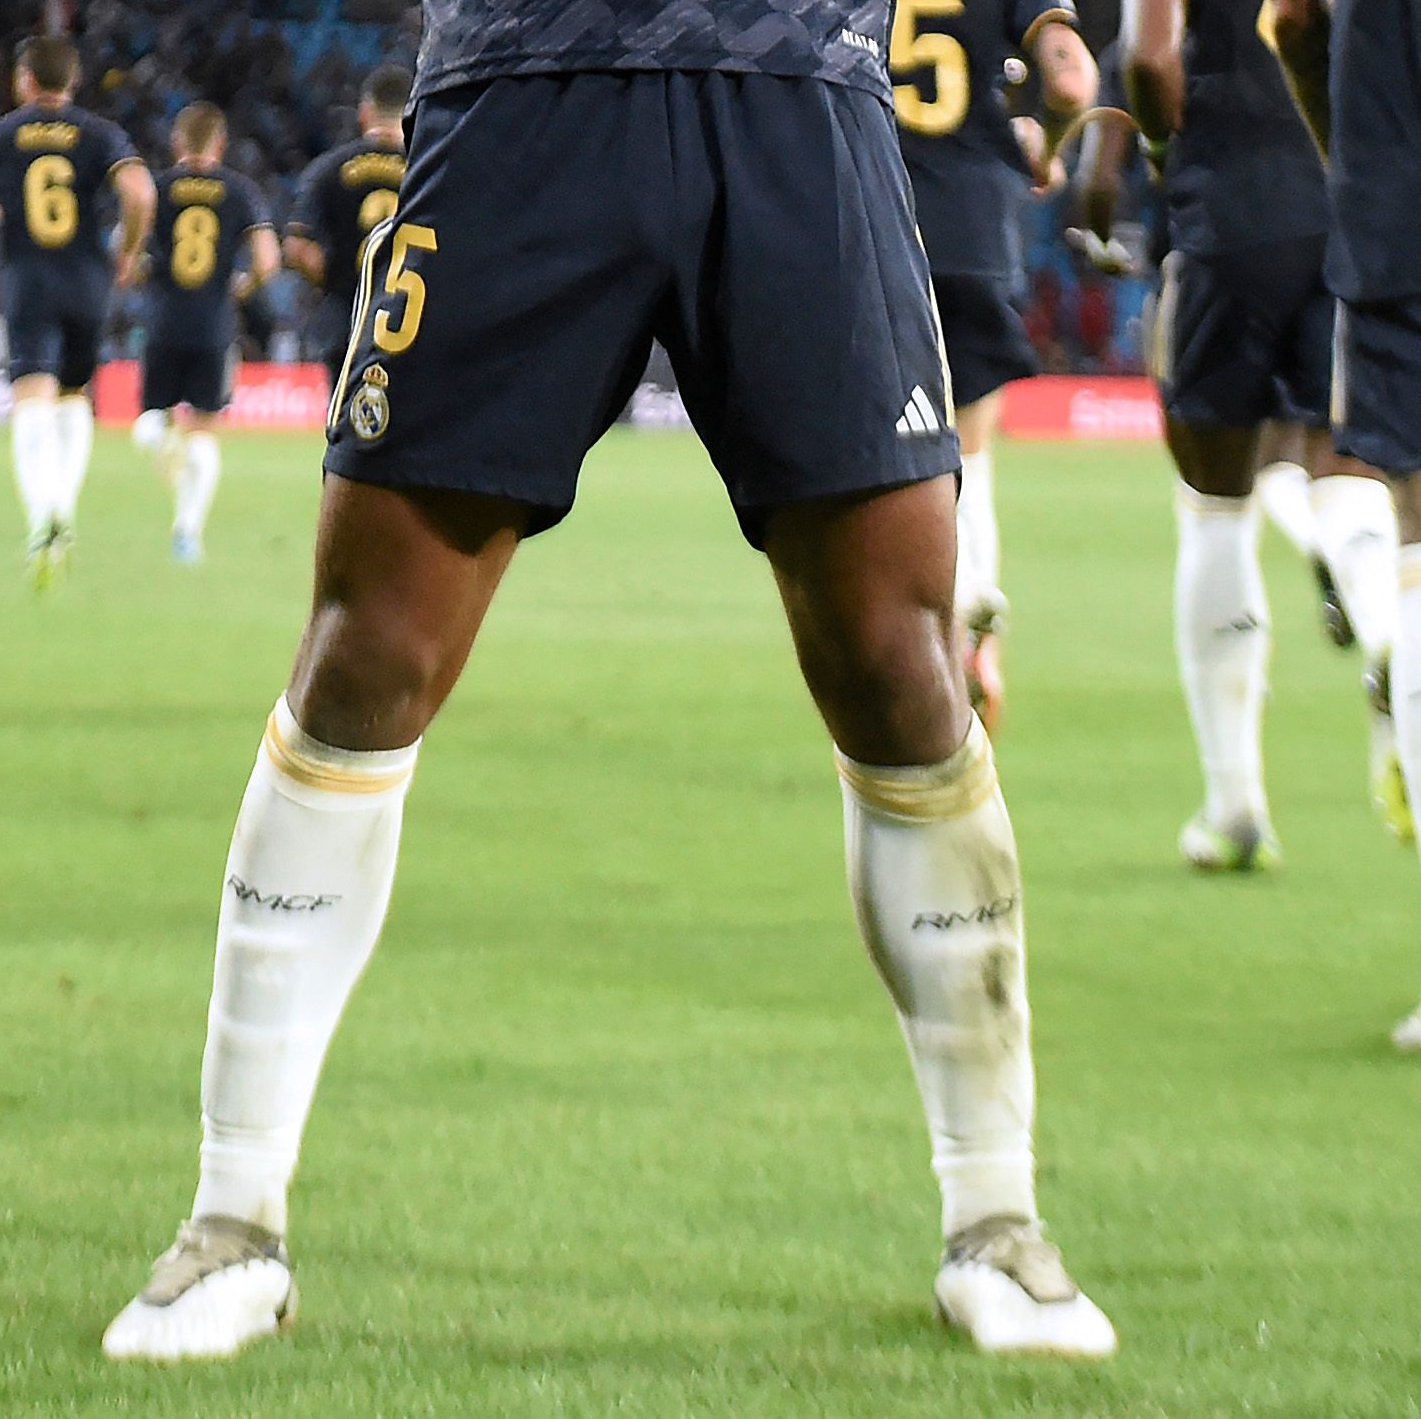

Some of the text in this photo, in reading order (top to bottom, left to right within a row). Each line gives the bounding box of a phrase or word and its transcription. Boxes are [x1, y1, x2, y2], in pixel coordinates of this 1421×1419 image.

[23, 154, 79, 249] 6
[171, 204, 219, 289] 8
[227, 873, 343, 911] RMCF
